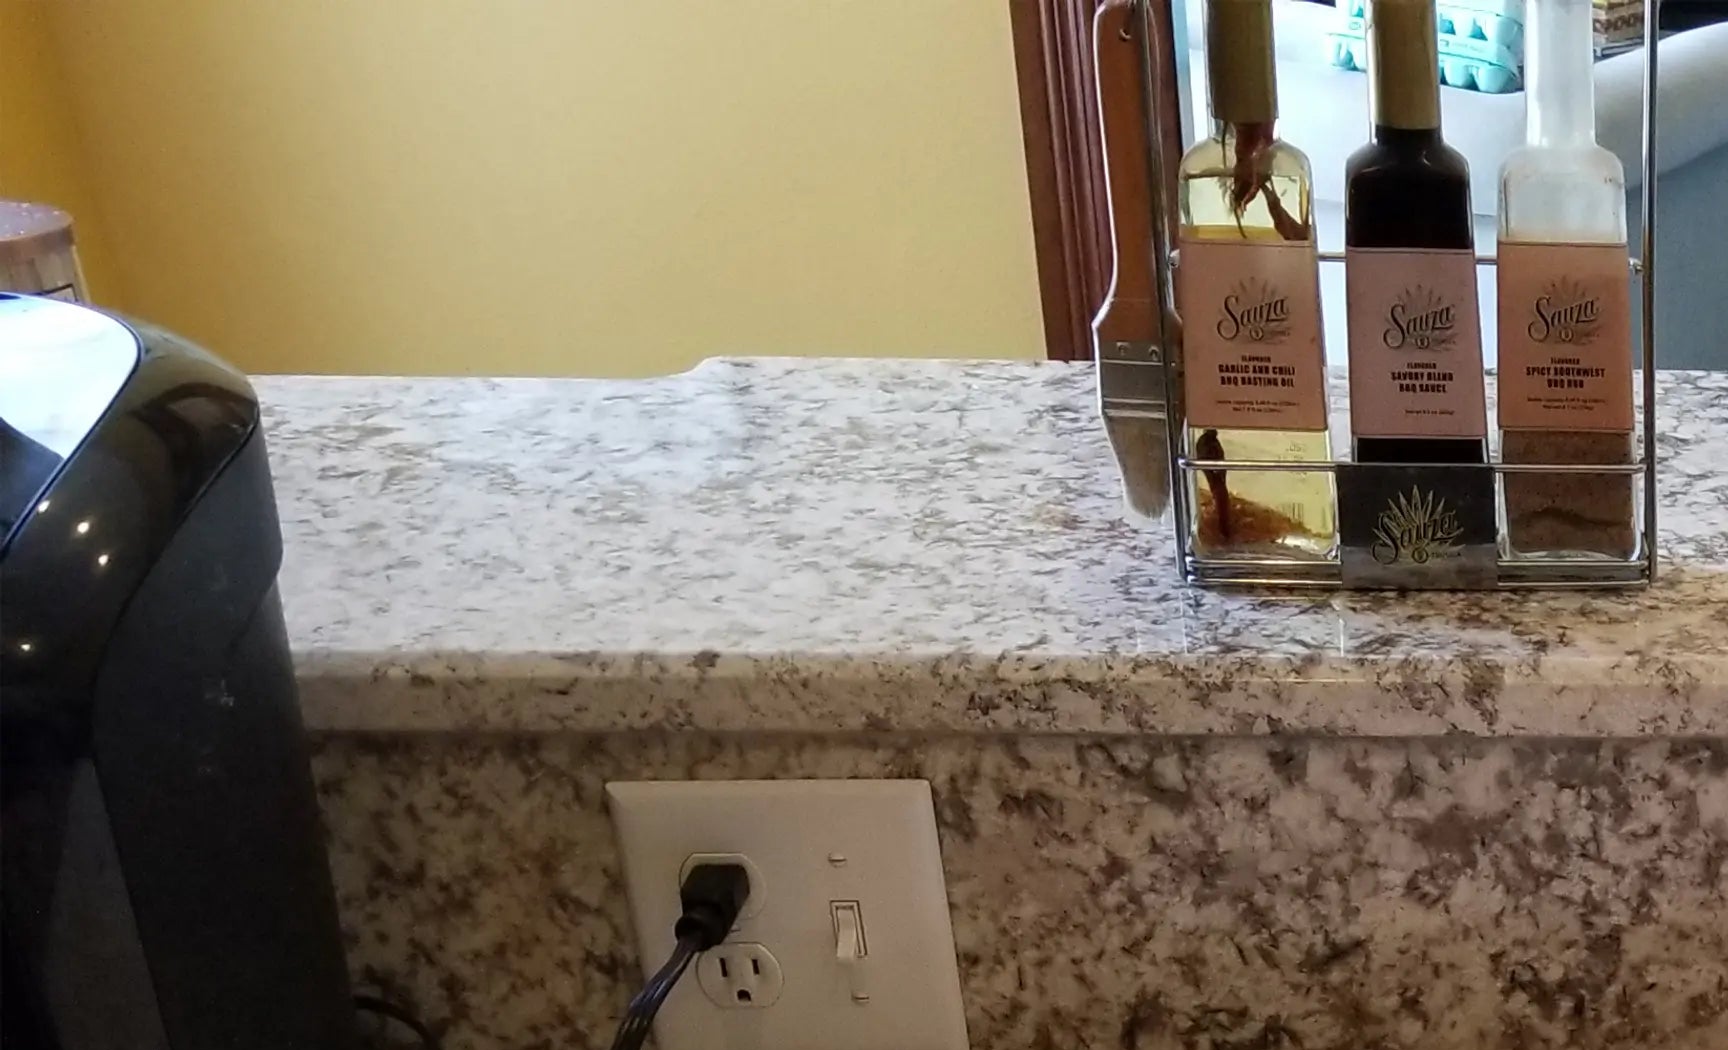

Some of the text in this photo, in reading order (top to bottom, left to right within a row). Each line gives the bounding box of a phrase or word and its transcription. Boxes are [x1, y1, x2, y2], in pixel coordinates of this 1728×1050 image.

[1217, 295, 1290, 341] Sauza
[1528, 297, 1599, 344] Sauza
[1383, 303, 1455, 349] Sauza
[1218, 363, 1250, 374] GARLIC
[1526, 366, 1606, 378] SPICY SOUTHWEST
[1241, 376, 1279, 387] BASTING
[1281, 377, 1295, 388] OIL
[1391, 371, 1424, 381] SAVORY
[1419, 383, 1447, 393] SAUCE
[1370, 511, 1459, 565] Sauza
